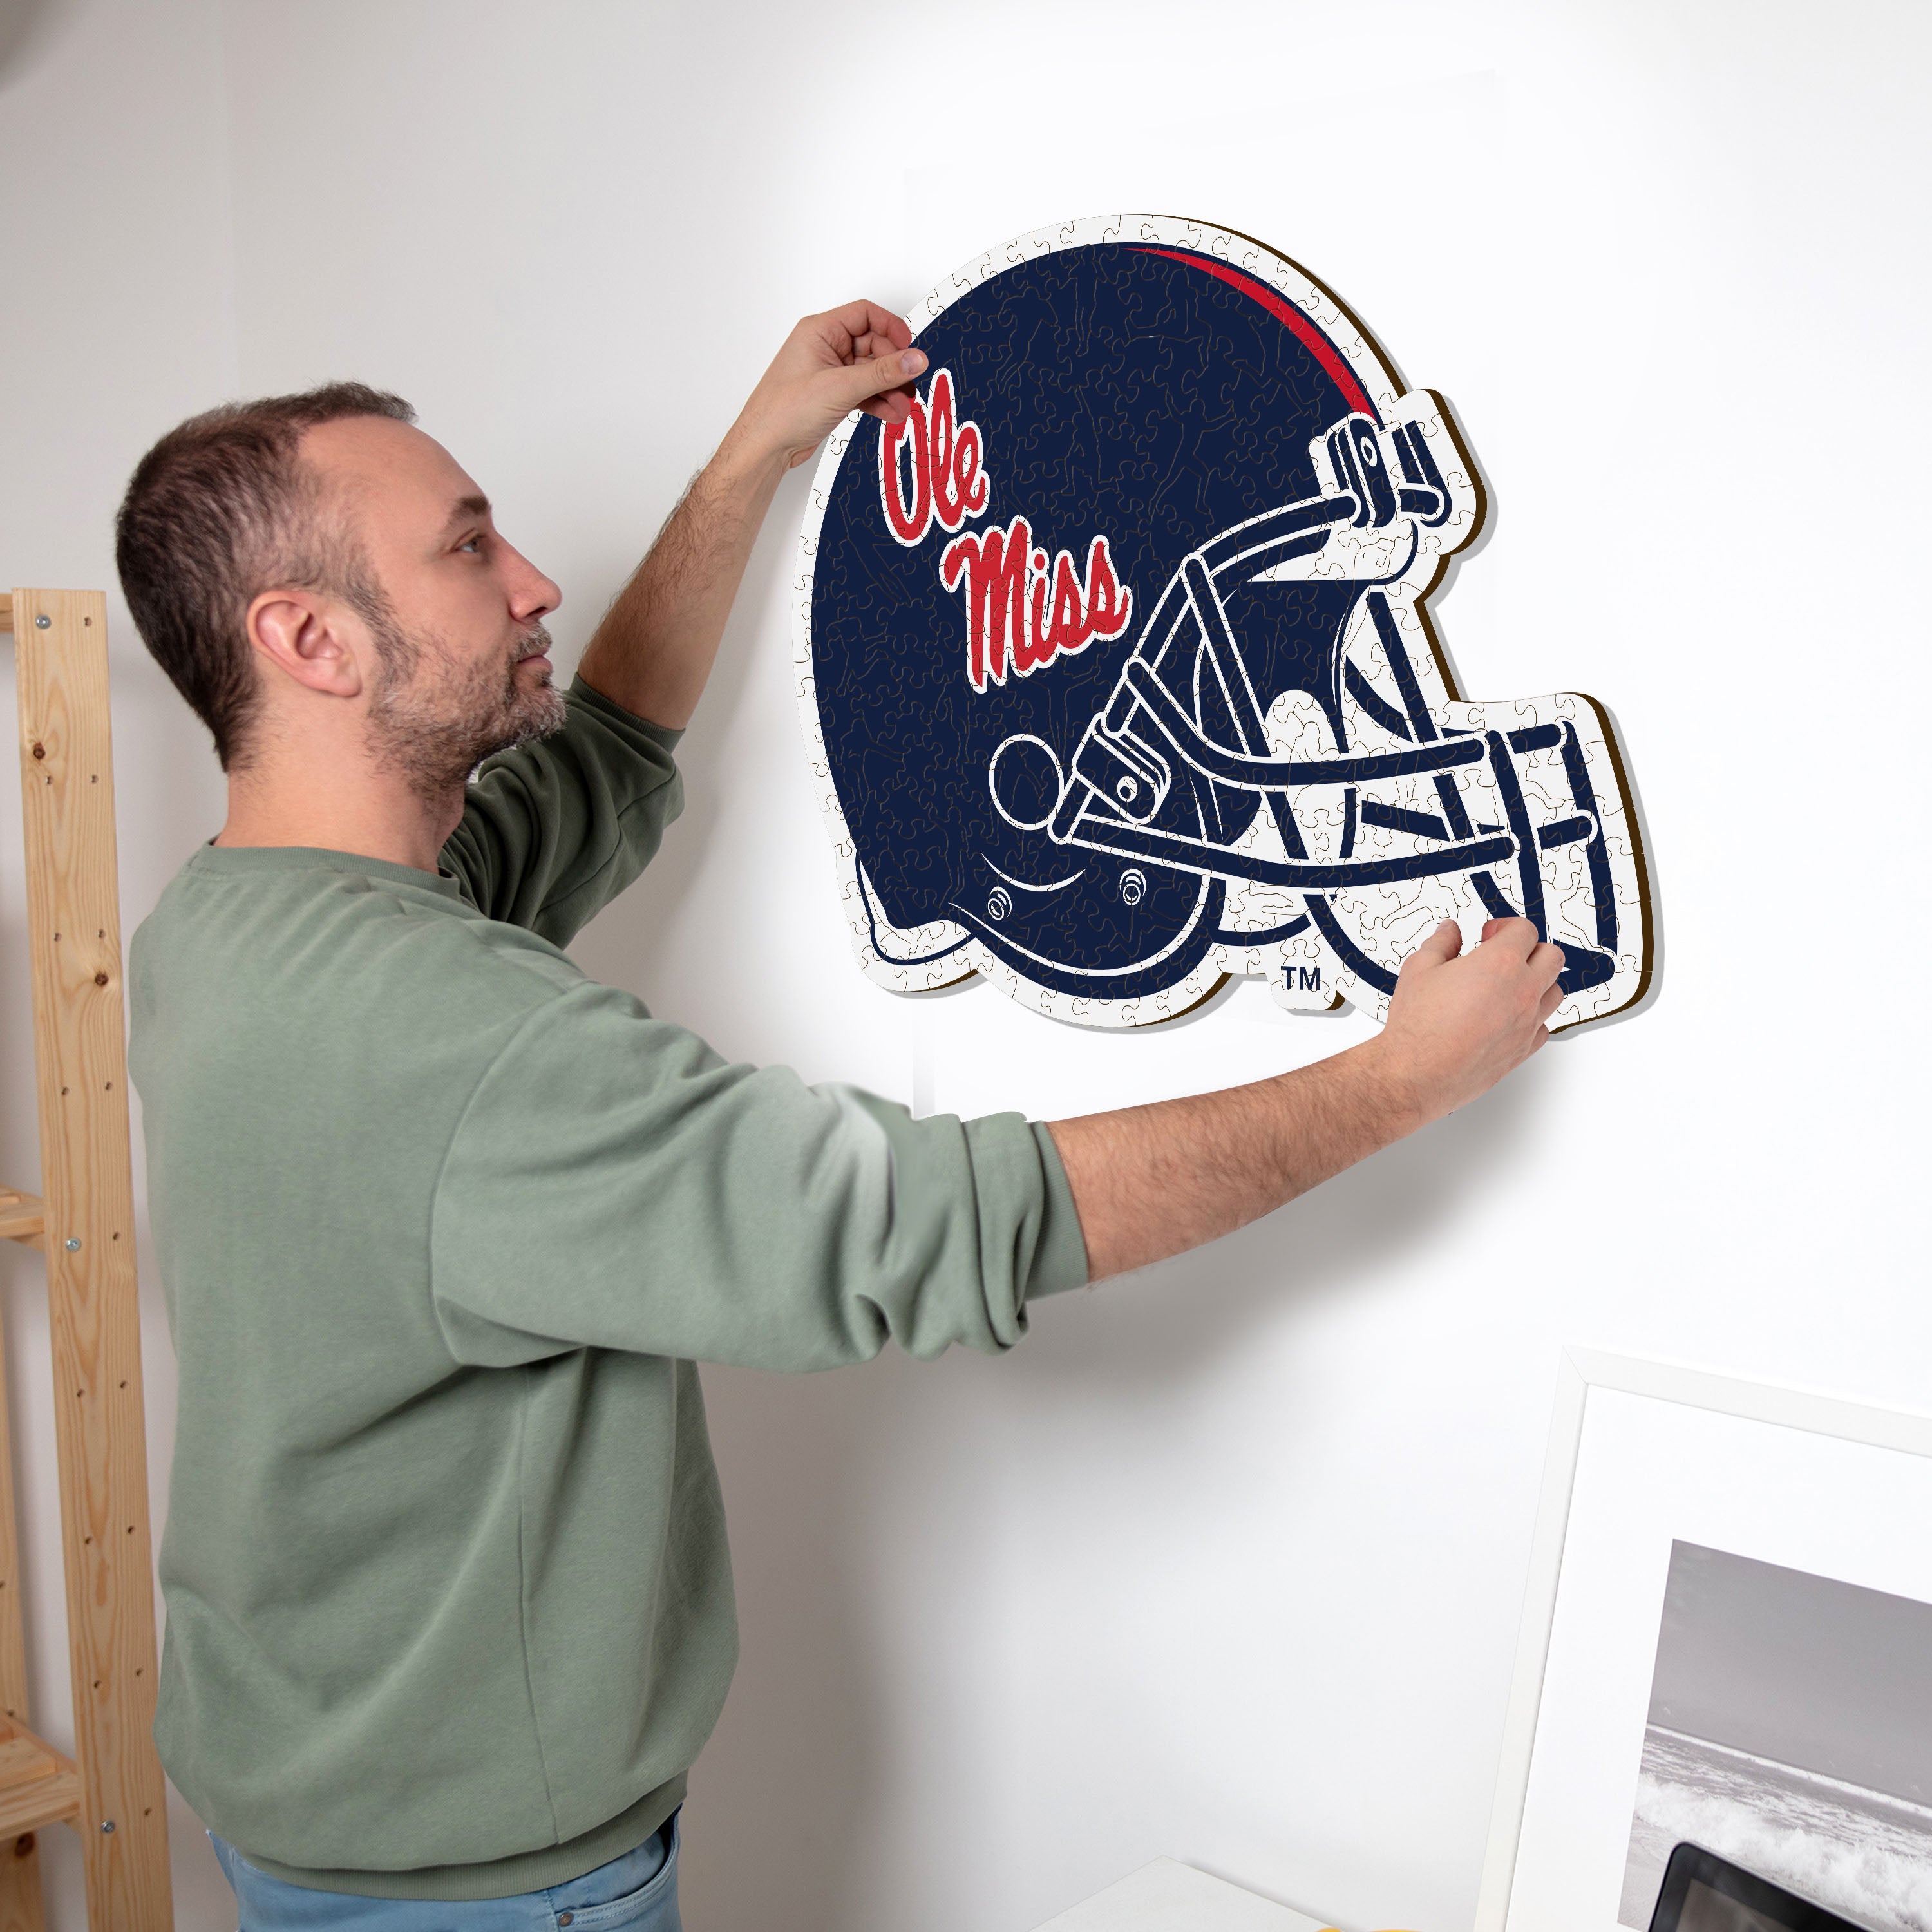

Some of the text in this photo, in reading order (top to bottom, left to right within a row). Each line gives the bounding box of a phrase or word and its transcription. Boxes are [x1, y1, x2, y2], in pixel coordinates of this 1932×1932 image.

[880, 369, 989, 545] Ole
[940, 516, 1131, 692] Miss
[1280, 965, 1321, 991] TM
